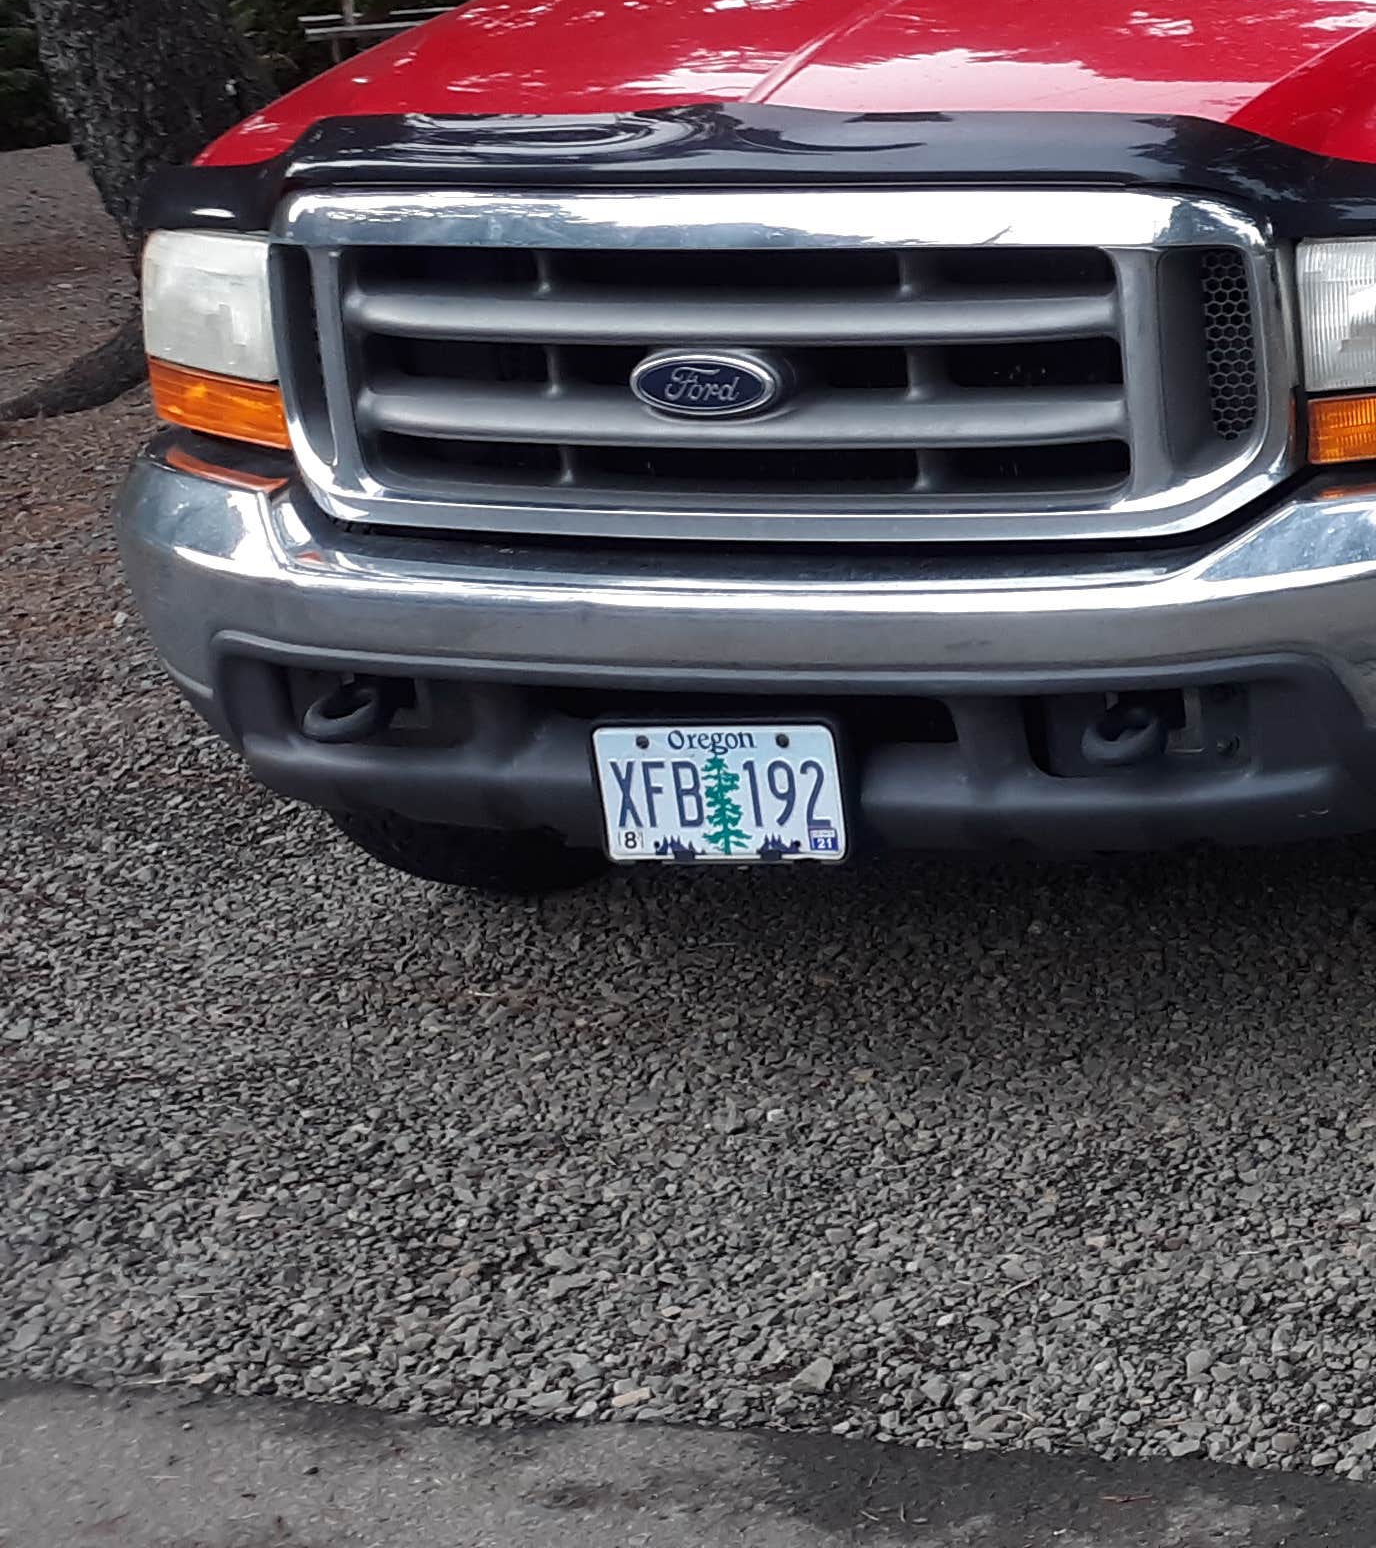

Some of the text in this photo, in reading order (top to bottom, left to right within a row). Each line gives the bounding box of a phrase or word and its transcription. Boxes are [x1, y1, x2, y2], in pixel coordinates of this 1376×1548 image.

[664, 366, 741, 402] Ford
[667, 730, 755, 755] Oregon
[609, 759, 831, 828] XFB 192
[624, 831, 638, 849] 8
[816, 837, 833, 849] 21
